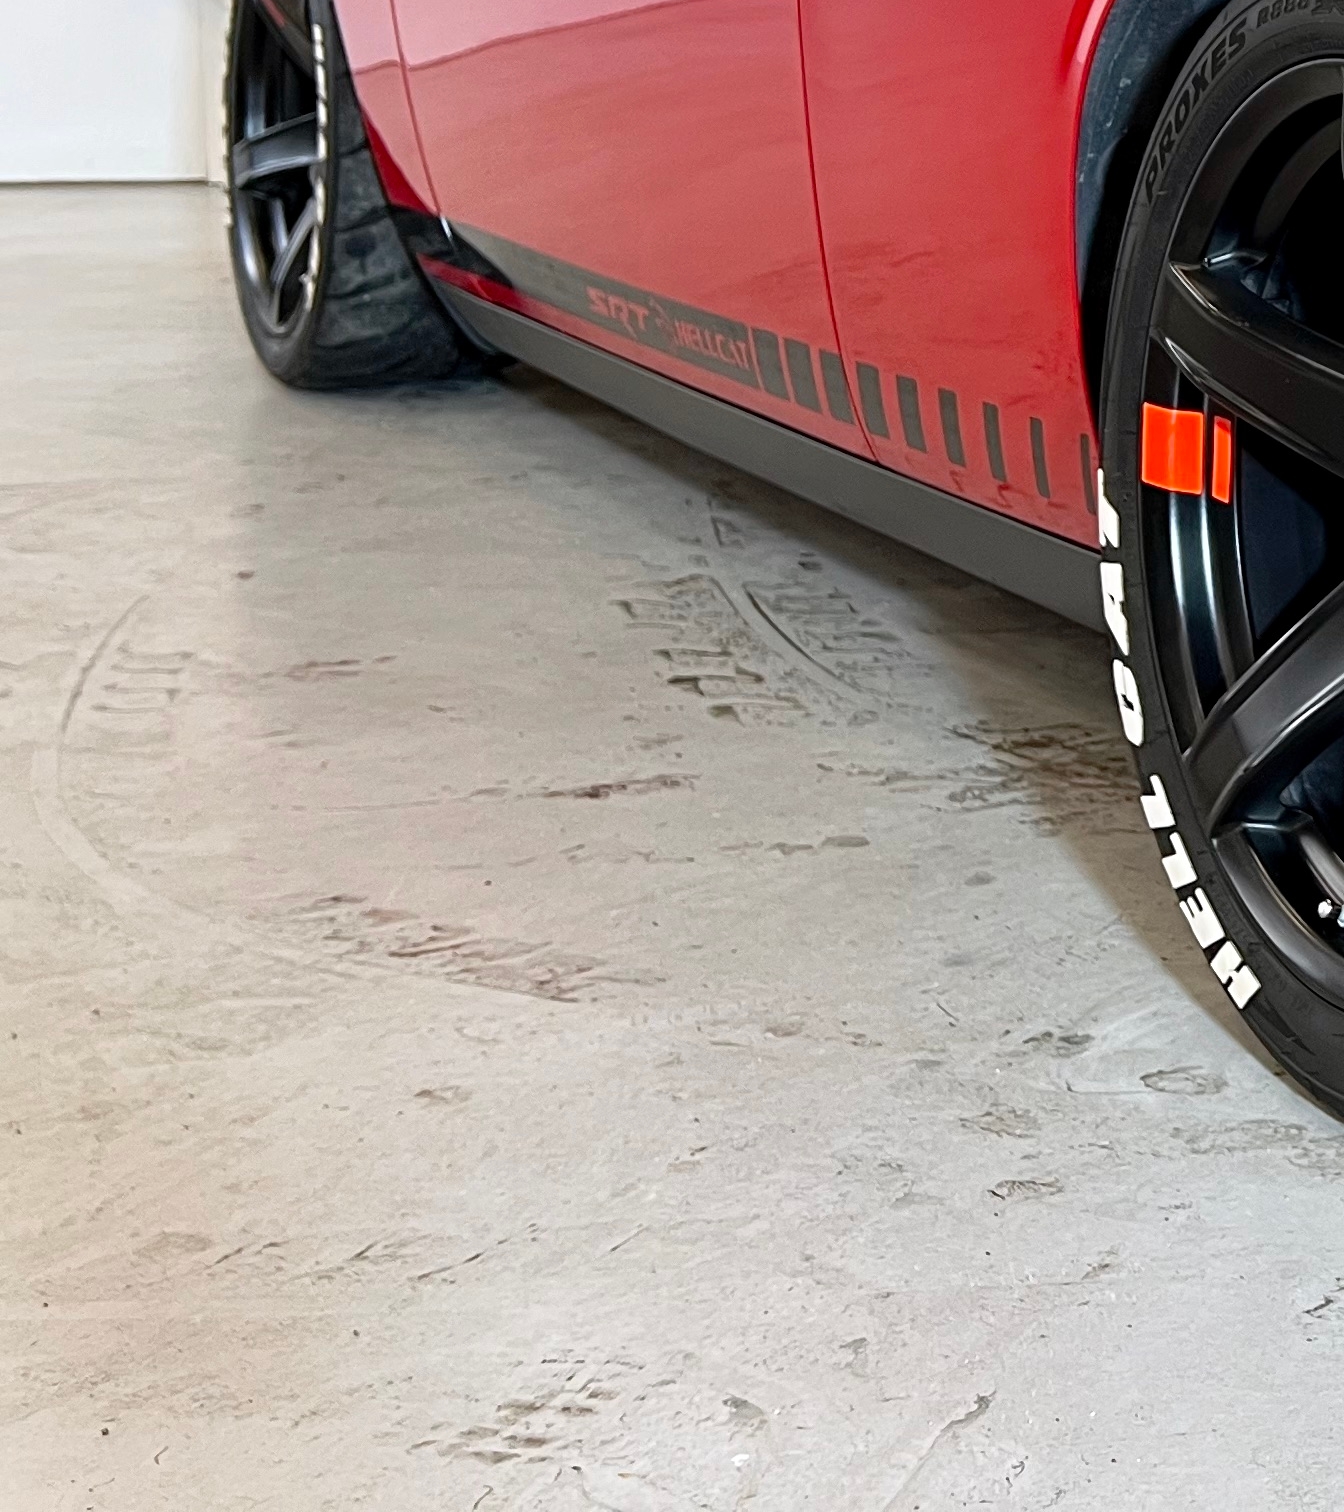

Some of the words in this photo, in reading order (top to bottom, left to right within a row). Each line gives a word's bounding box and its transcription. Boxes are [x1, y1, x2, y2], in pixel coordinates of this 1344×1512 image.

[1145, 16, 1248, 205] PROXES
[587, 287, 650, 337] SRT
[674, 318, 750, 370] HELLCAT
[1097, 468, 1144, 747] CAT
[1141, 775, 1261, 1008] HELL
